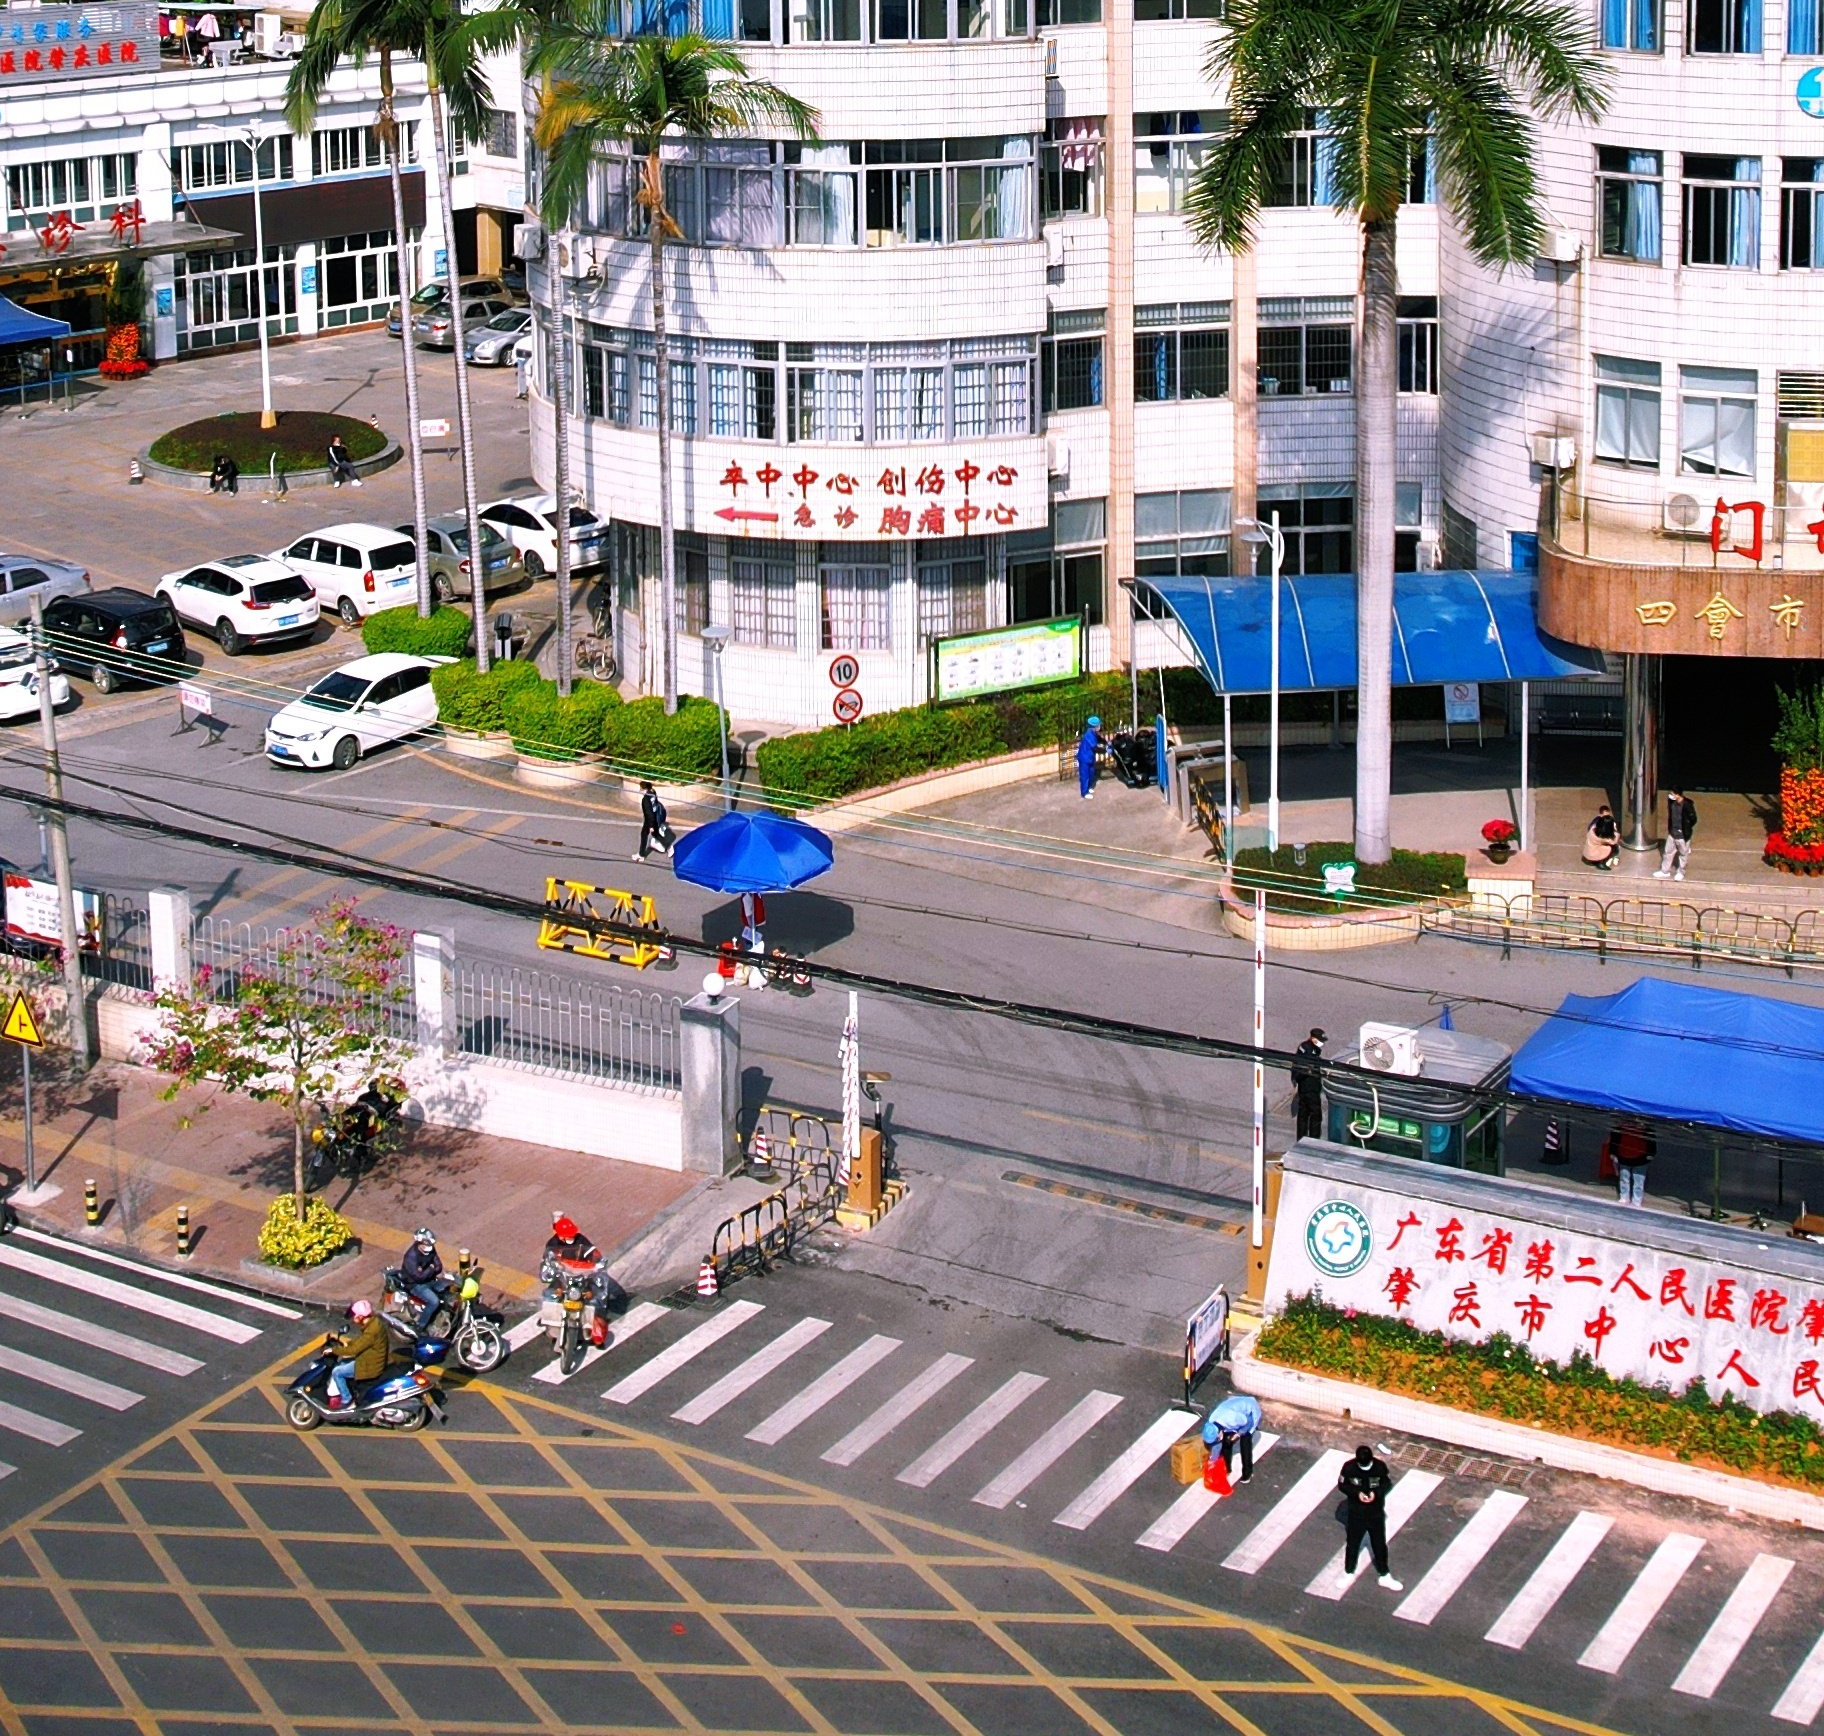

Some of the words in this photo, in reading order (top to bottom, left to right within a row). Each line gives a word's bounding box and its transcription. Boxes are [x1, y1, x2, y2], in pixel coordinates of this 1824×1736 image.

[719, 459, 860, 499] 卒中中心
[876, 459, 1019, 497] 创伤中心
[794, 502, 859, 529] 急诊
[878, 498, 1018, 536] 胸痛中心
[837, 663, 852, 682] 10
